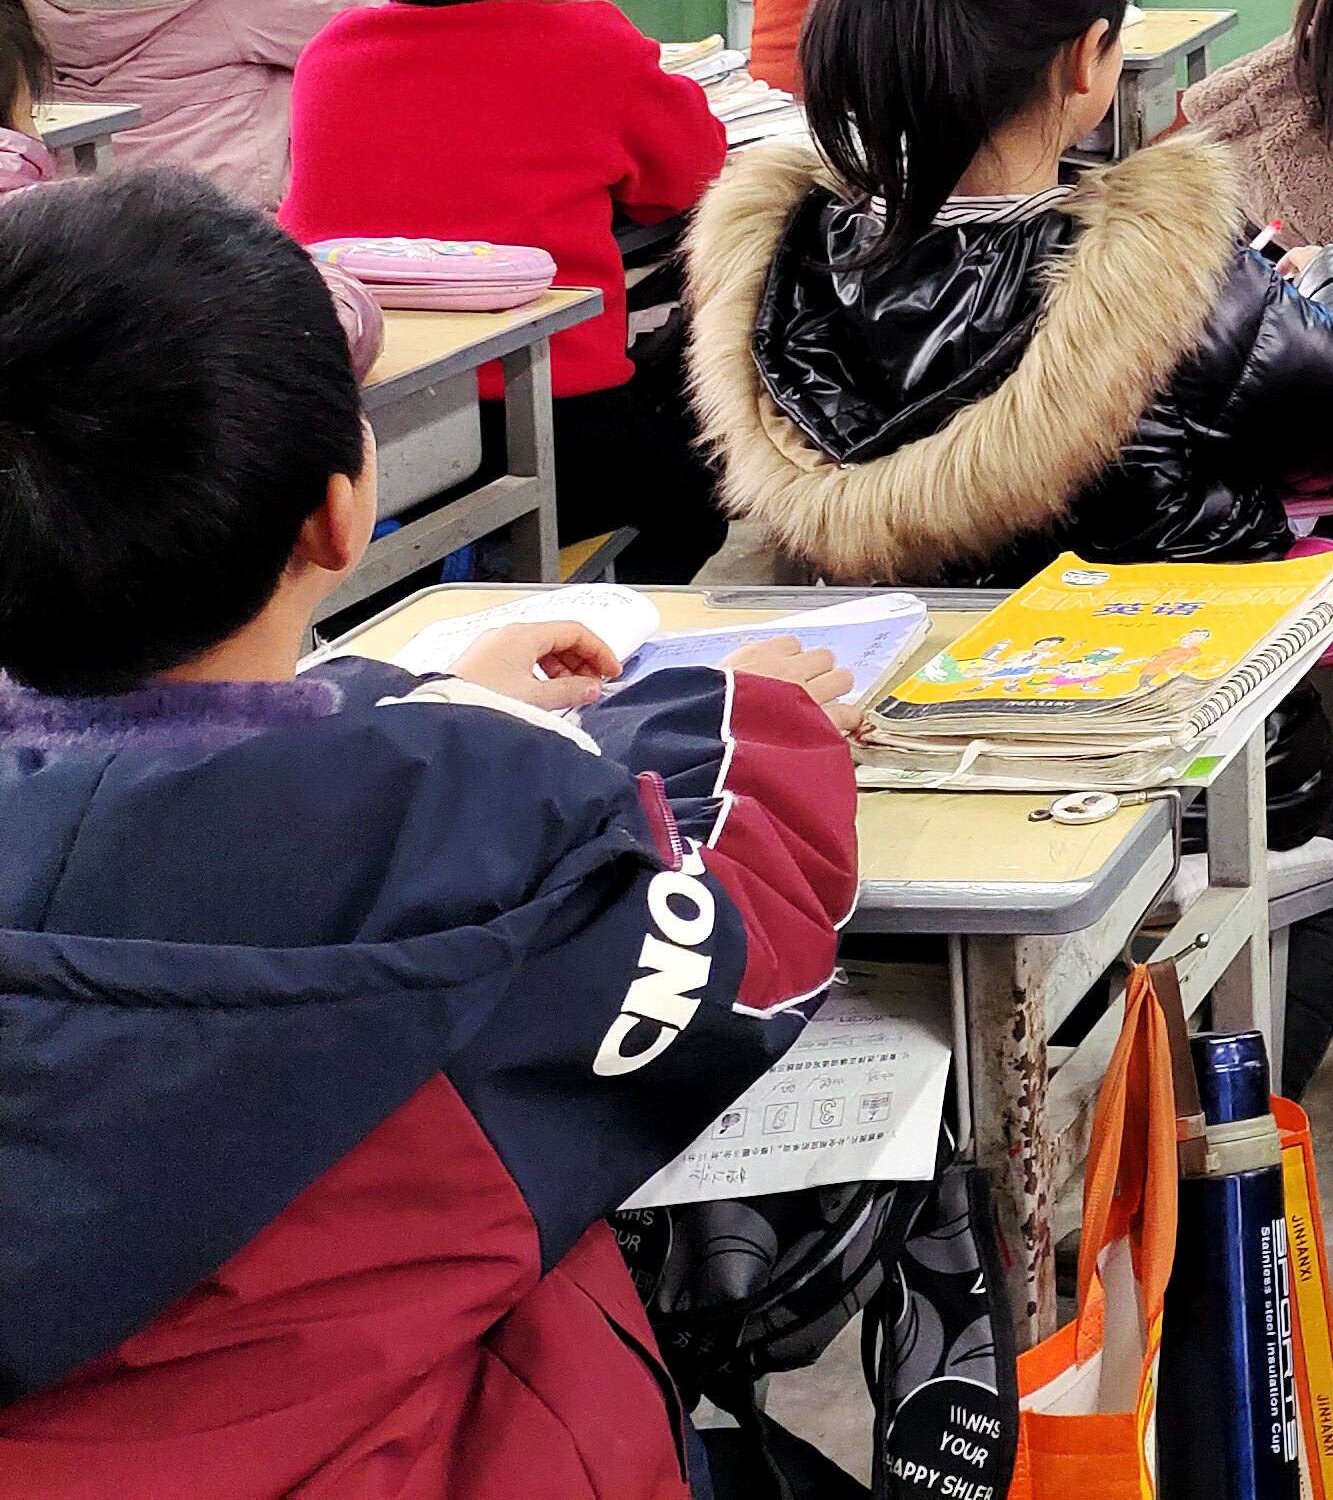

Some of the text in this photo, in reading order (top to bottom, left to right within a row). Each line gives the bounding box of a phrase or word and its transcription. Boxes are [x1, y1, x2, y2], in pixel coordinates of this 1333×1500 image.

[1260, 1226, 1273, 1295] Stainless
[1265, 1300, 1277, 1336] steel
[1276, 1216, 1299, 1461] SPORTS
[939, 1430, 989, 1469] YOUR
[1271, 1423, 1282, 1454] Cup
